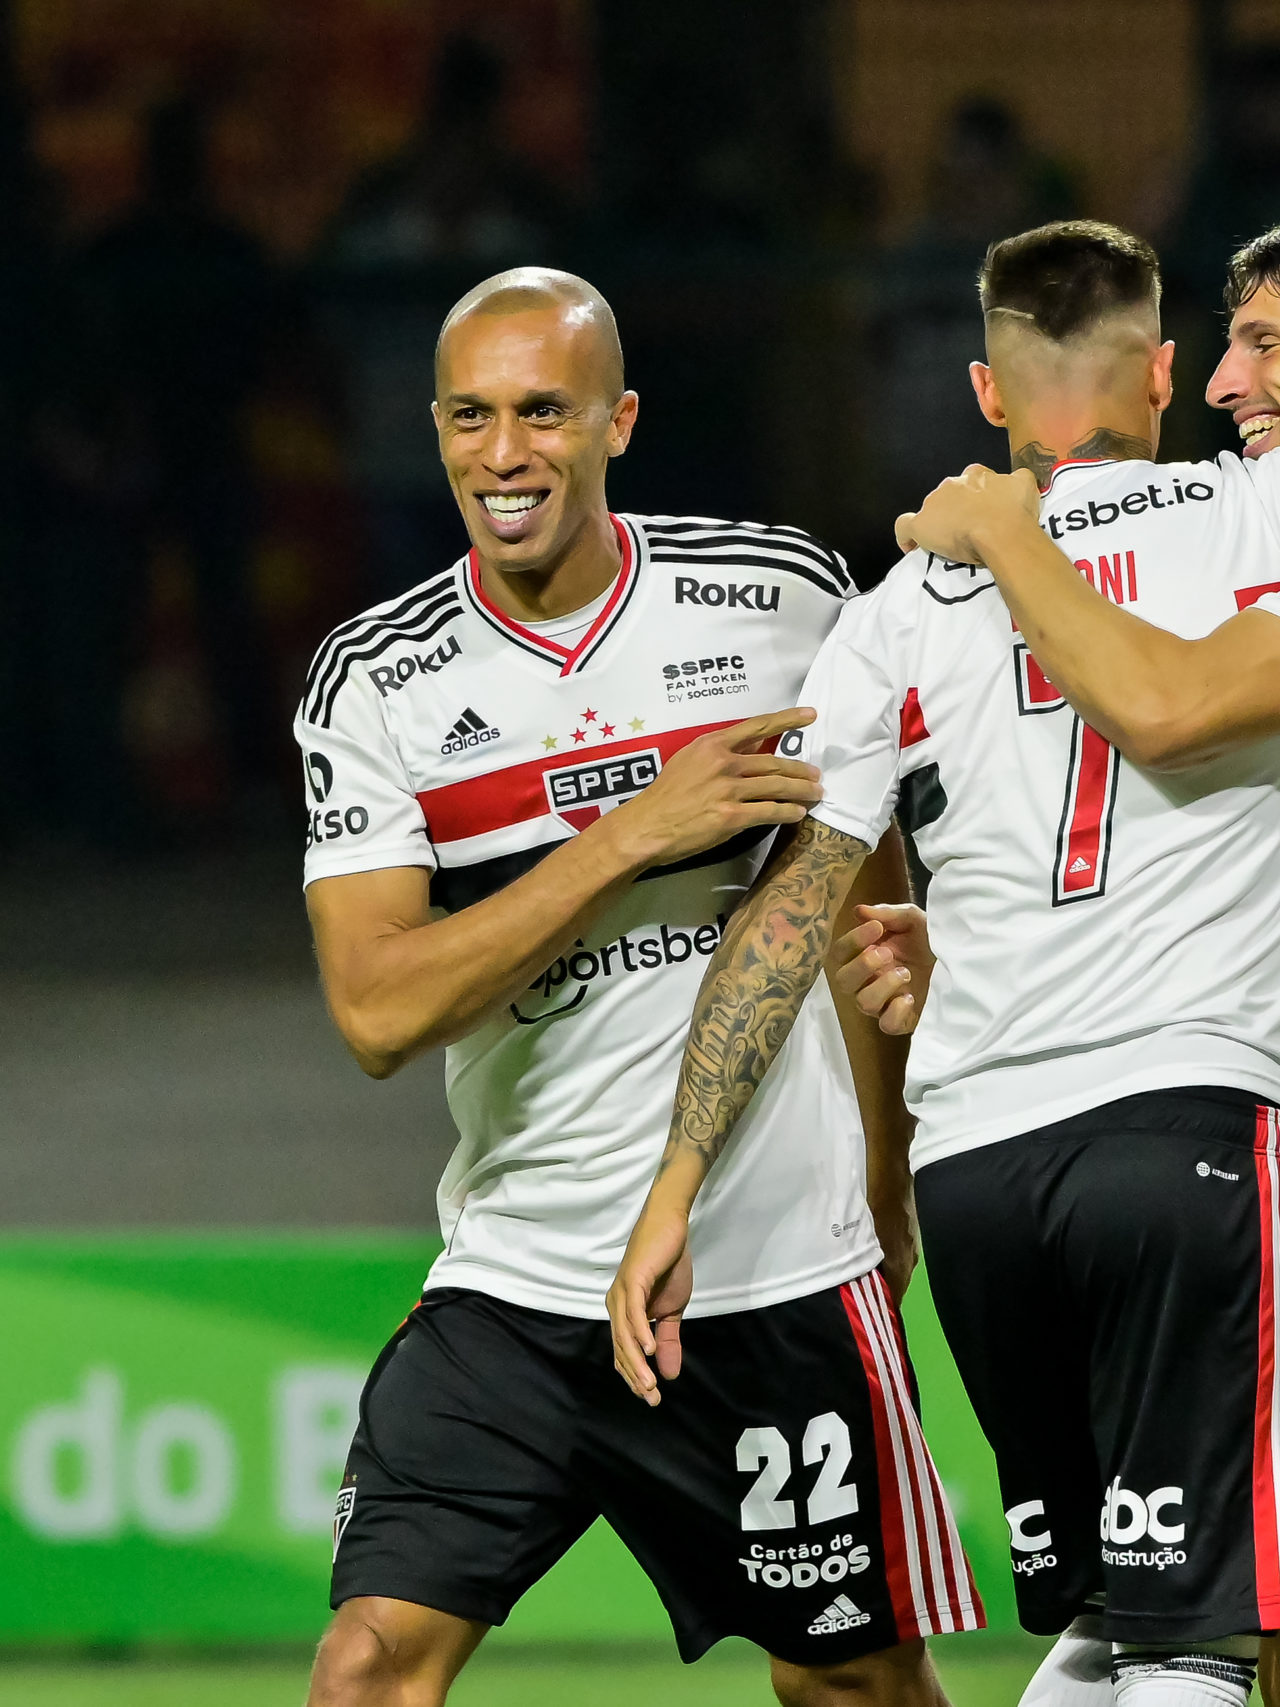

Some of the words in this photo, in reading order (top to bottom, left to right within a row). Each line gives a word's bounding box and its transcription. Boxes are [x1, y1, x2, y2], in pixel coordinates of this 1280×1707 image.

[666, 679, 697, 692] FAN
[701, 673, 747, 685] TOKEN
[667, 693, 683, 703] by
[441, 725, 501, 757] adidas
[553, 760, 655, 802] SPFC
[308, 806, 369, 848] tso
[15, 1361, 236, 1540] do
[735, 1411, 859, 1531] 22
[750, 1544, 823, 1560] Cartão
[829, 1534, 853, 1551] de
[738, 1545, 871, 1588] TODOS
[807, 1612, 872, 1636] adidas
